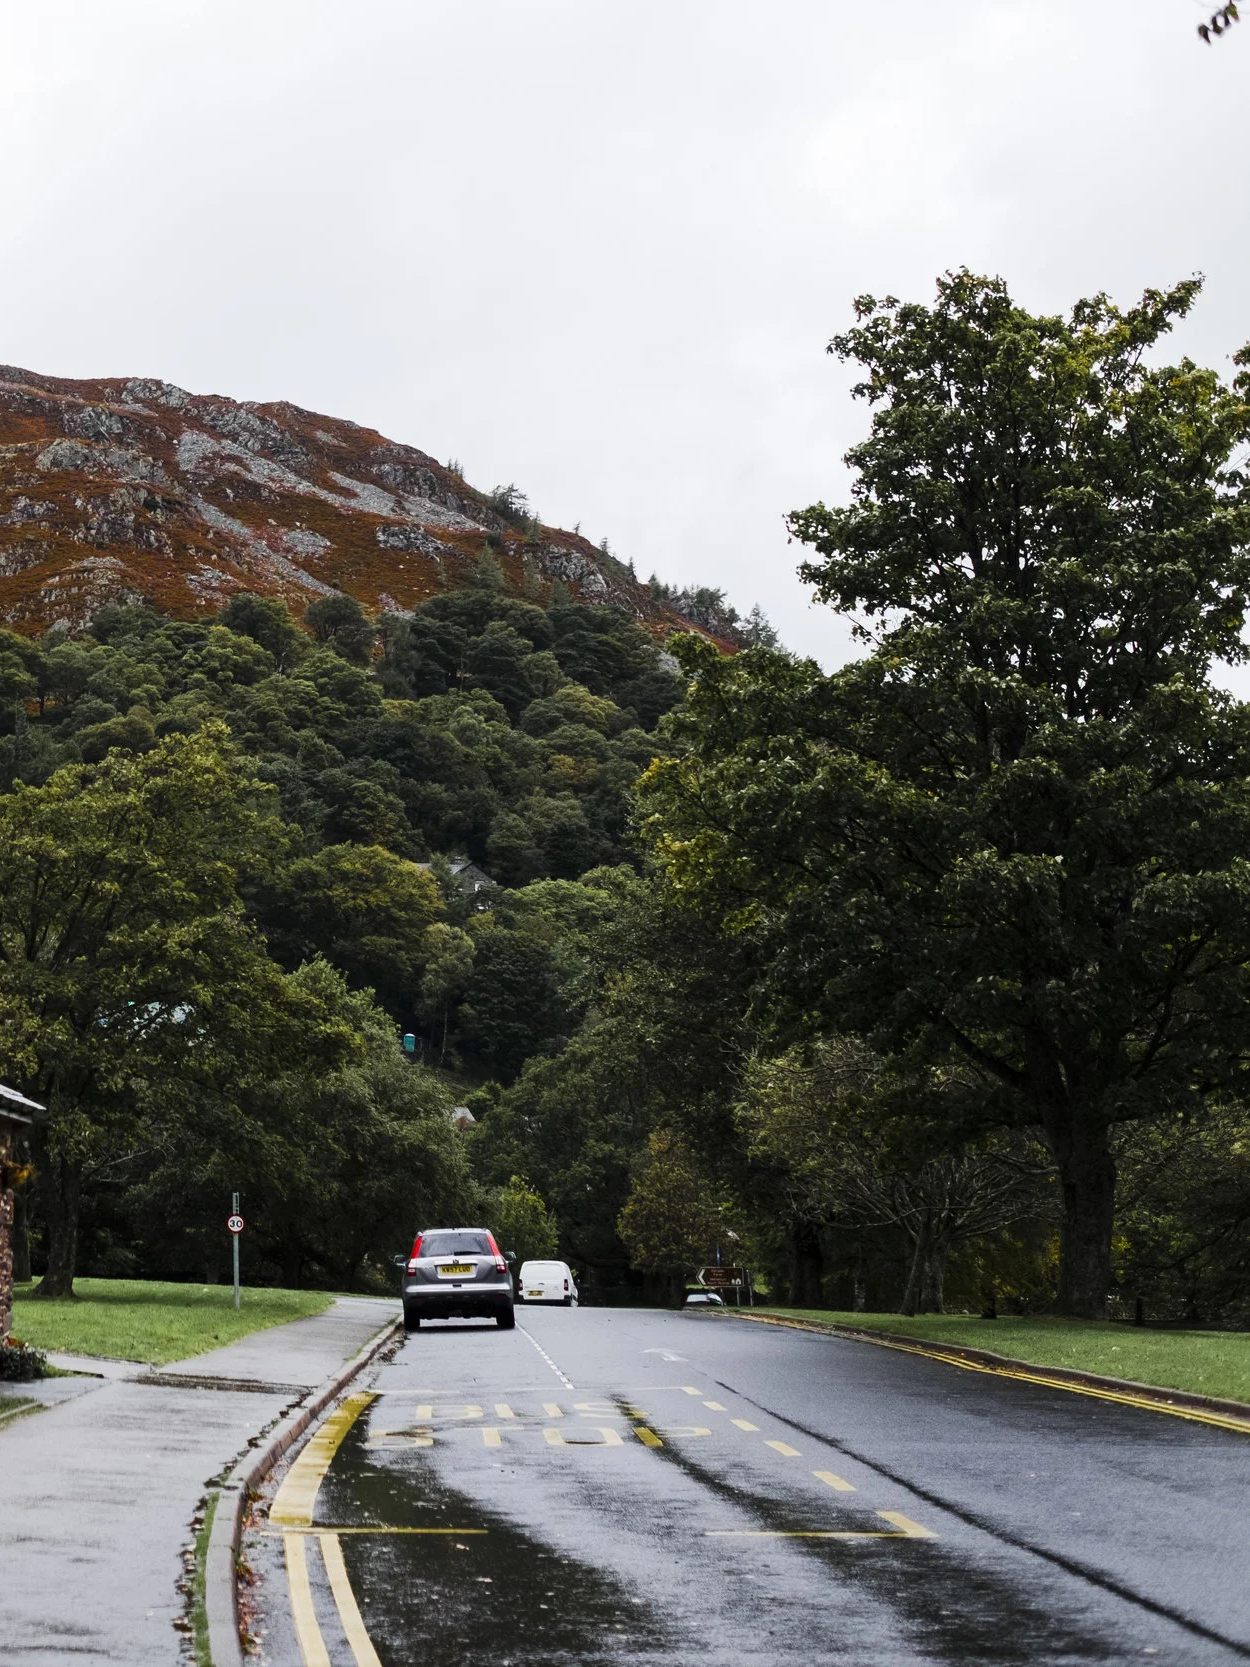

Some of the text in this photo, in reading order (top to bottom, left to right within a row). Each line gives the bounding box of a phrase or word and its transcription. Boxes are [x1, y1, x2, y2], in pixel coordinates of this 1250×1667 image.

[229, 1219, 243, 1228] 30
[416, 1402, 648, 1419] BUS
[363, 1426, 712, 1447] STOP
